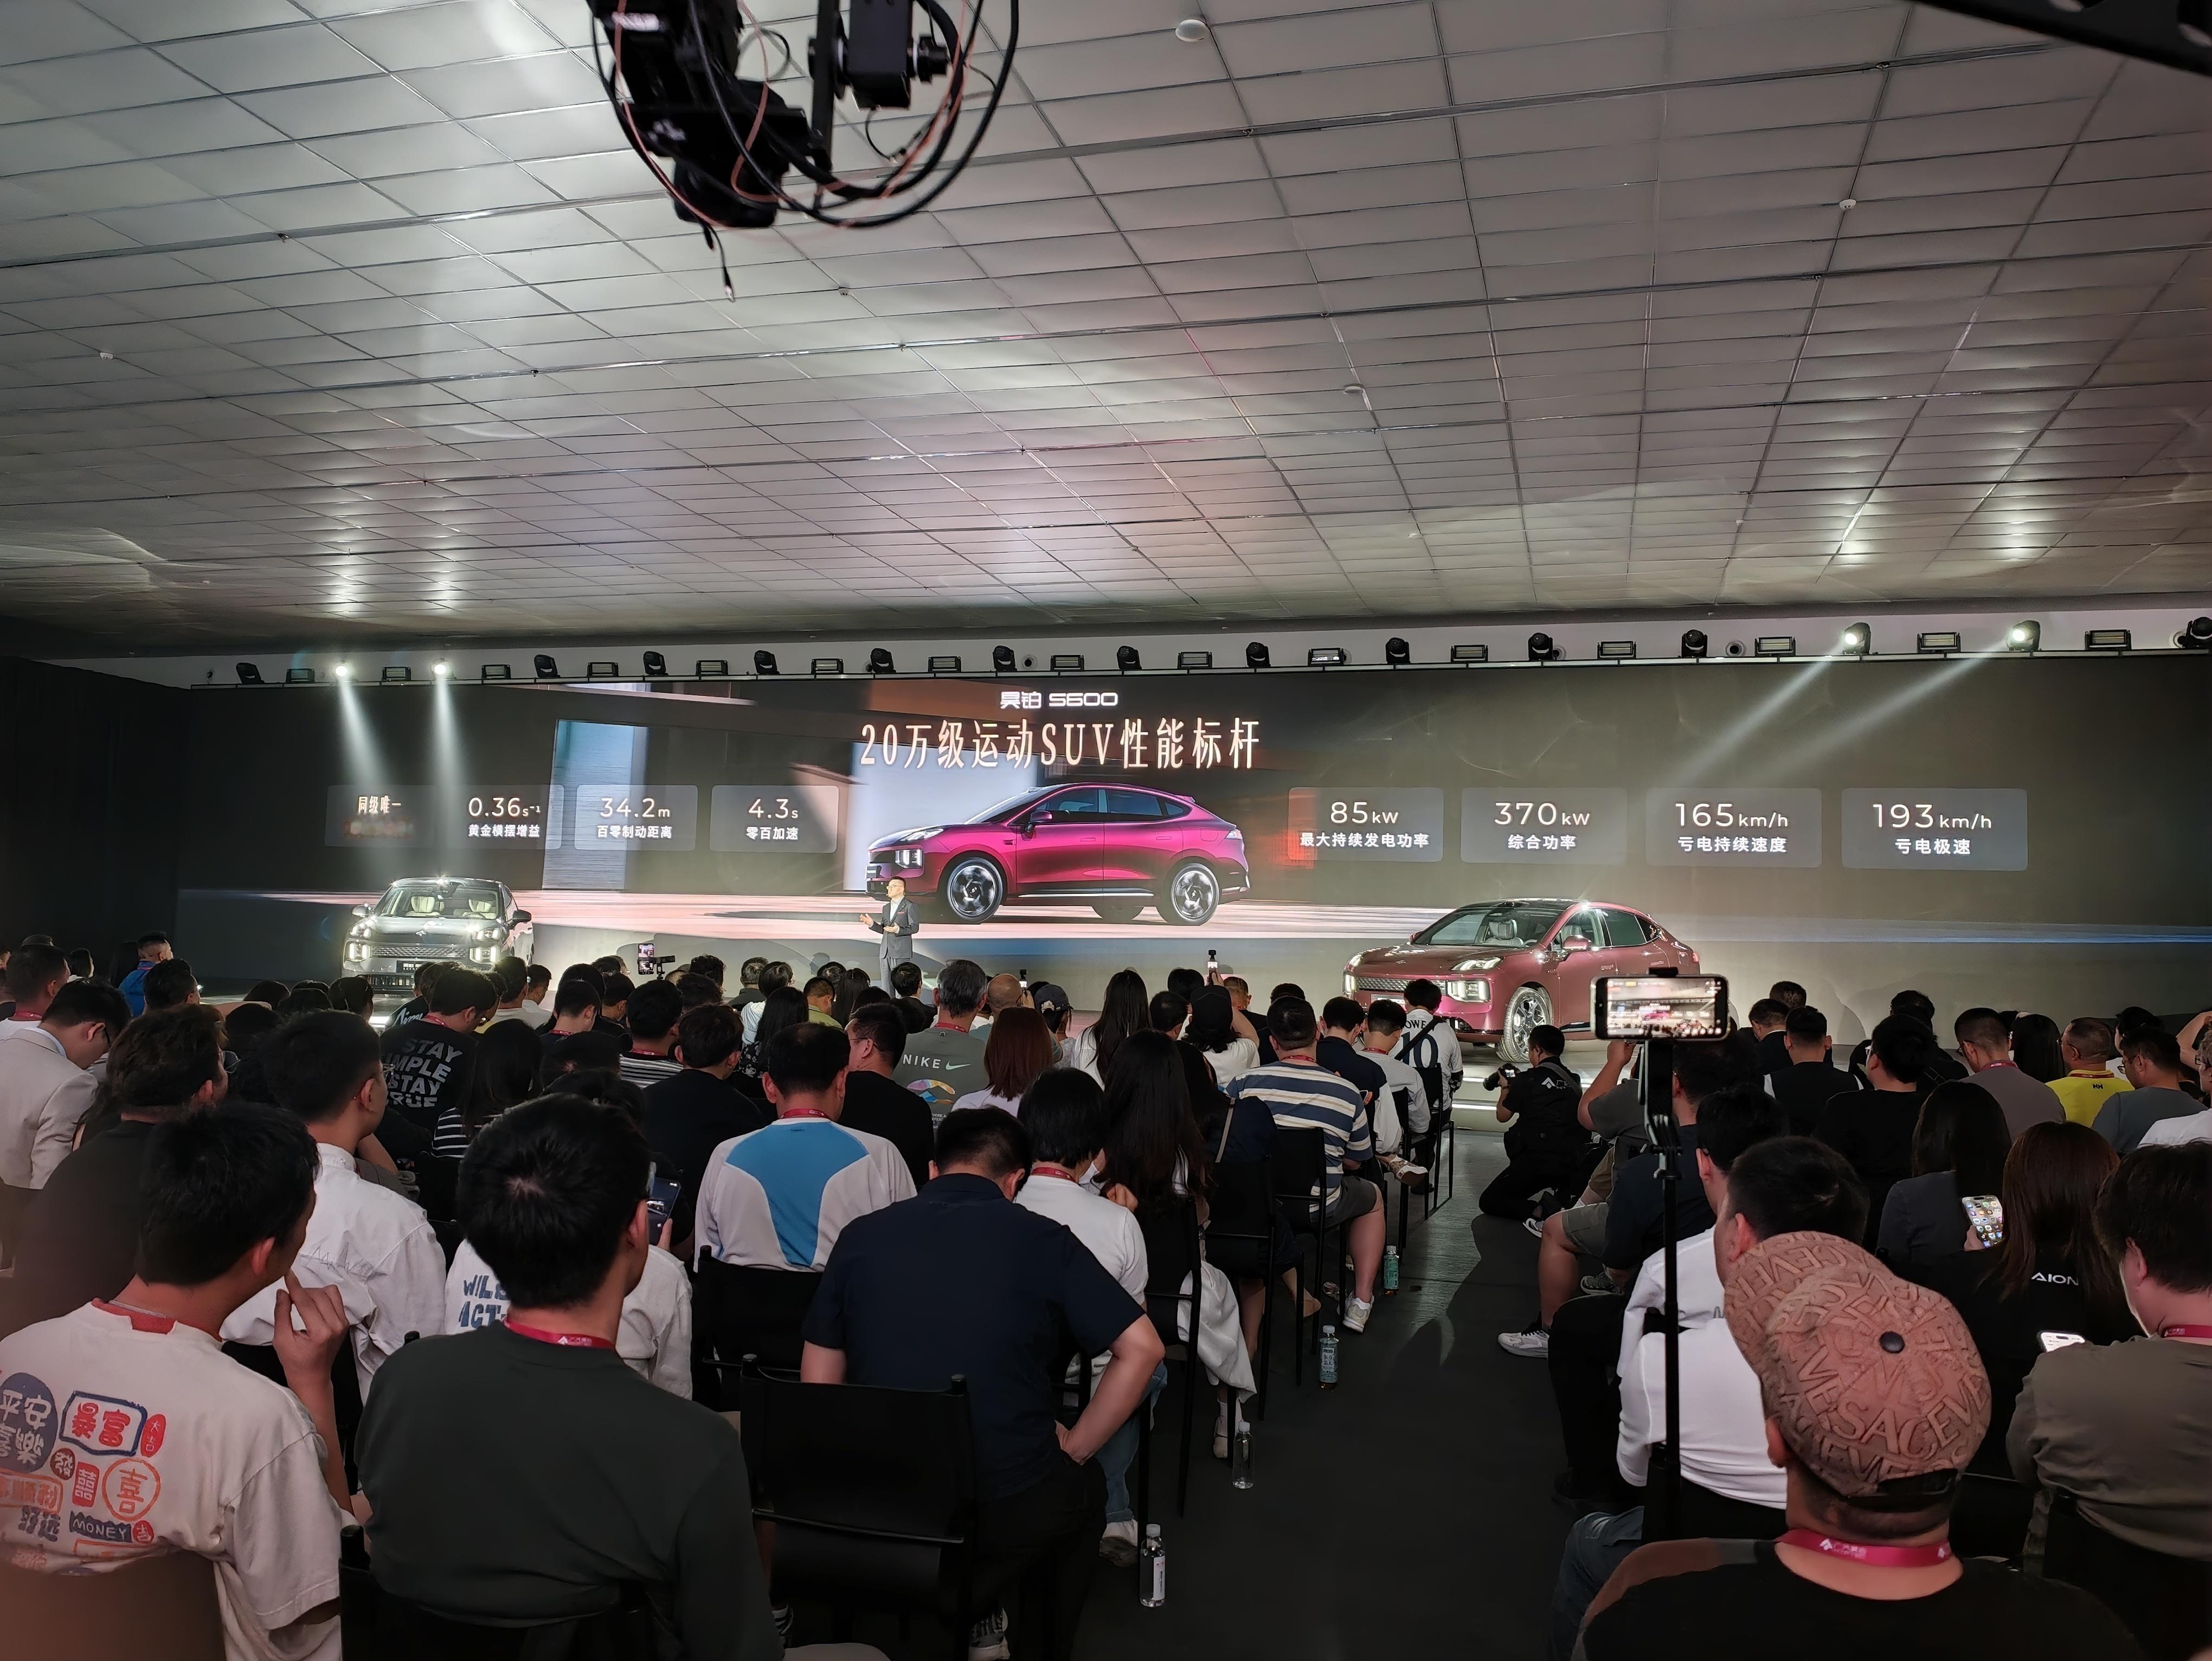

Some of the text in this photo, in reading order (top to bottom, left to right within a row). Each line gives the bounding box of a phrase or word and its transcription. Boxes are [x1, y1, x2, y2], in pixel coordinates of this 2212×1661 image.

[1000, 691, 1042, 709] 昊铂
[860, 718, 1260, 769] 20万级运动SUV性能标杆
[468, 824, 540, 838] 黄金横摆增益
[597, 825, 672, 839] 百零制动距离
[745, 826, 799, 841] 零百加速
[1299, 832, 1430, 848] 最大持续发电功率
[1508, 834, 1577, 850] 综合功率
[1678, 836, 1787, 853] 亏电持续速度
[1895, 838, 1971, 855] 亏电极速
[1405, 1020, 1434, 1031] OWE
[402, 1038, 463, 1063] STAY
[383, 1053, 452, 1083] IMPLE
[903, 1054, 941, 1069] NIKE
[387, 1073, 442, 1096] STAY
[387, 1091, 438, 1108] RUE
[2031, 1272, 2079, 1286] AION
[72, 1518, 128, 1541] MONEY
